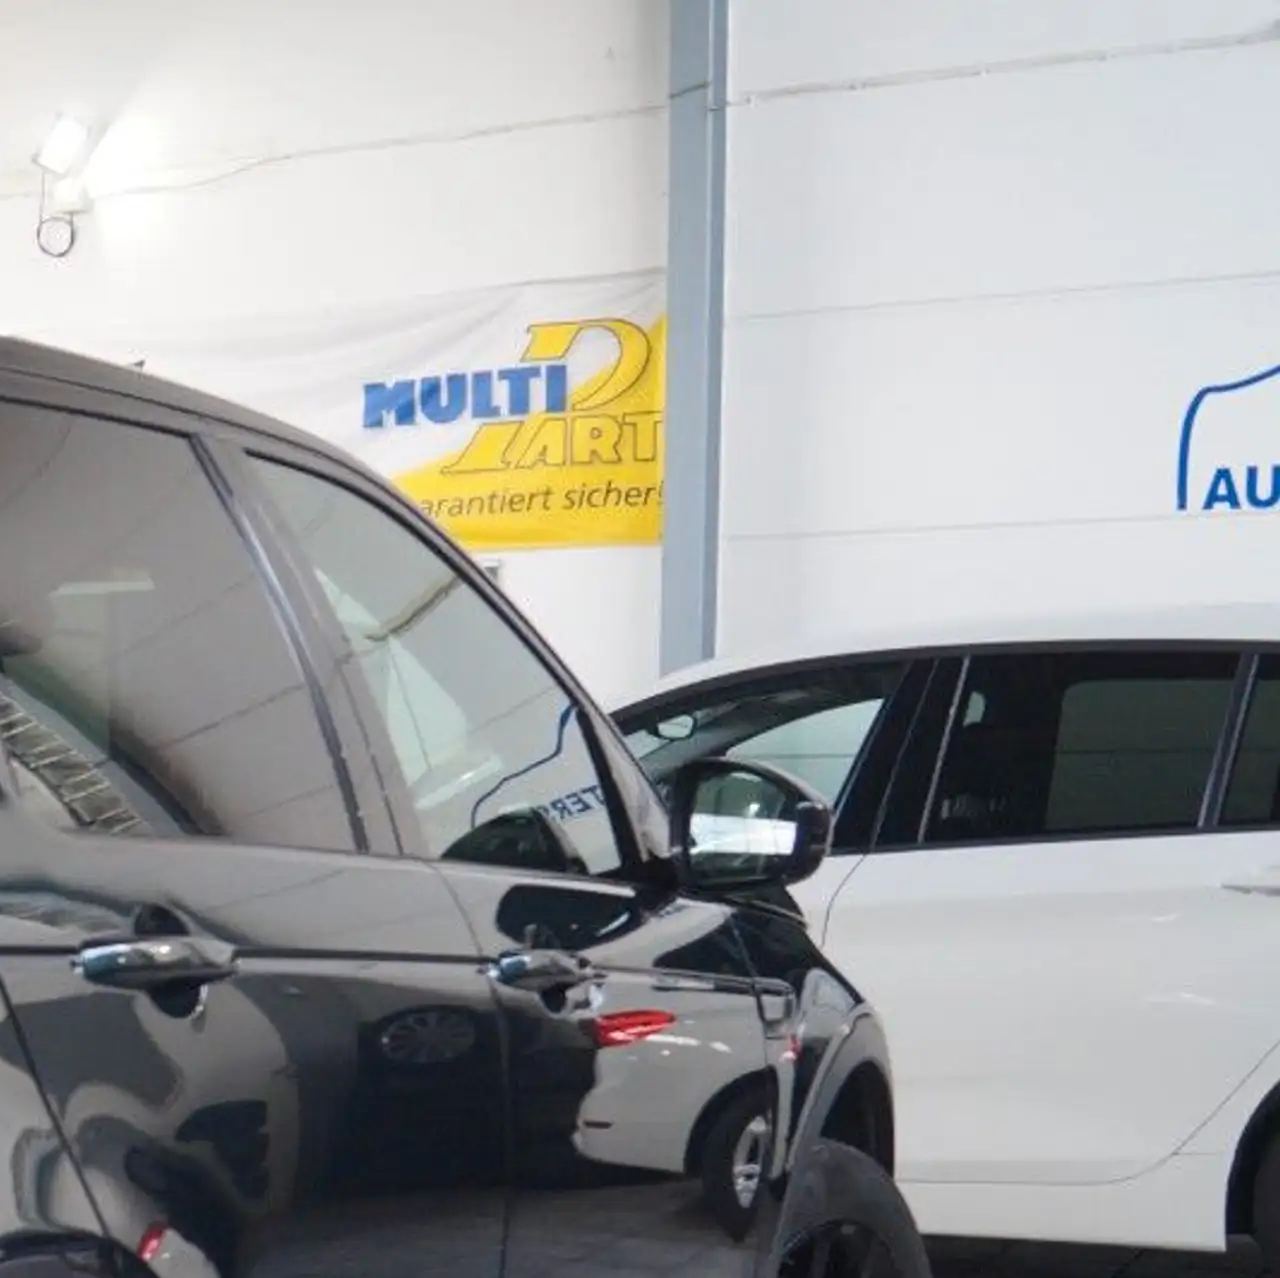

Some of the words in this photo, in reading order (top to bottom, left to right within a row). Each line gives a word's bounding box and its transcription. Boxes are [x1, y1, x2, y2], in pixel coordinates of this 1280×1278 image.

[363, 364, 568, 428] MULTI
[420, 488, 551, 517] arantiert
[1202, 465, 1280, 510] AU
